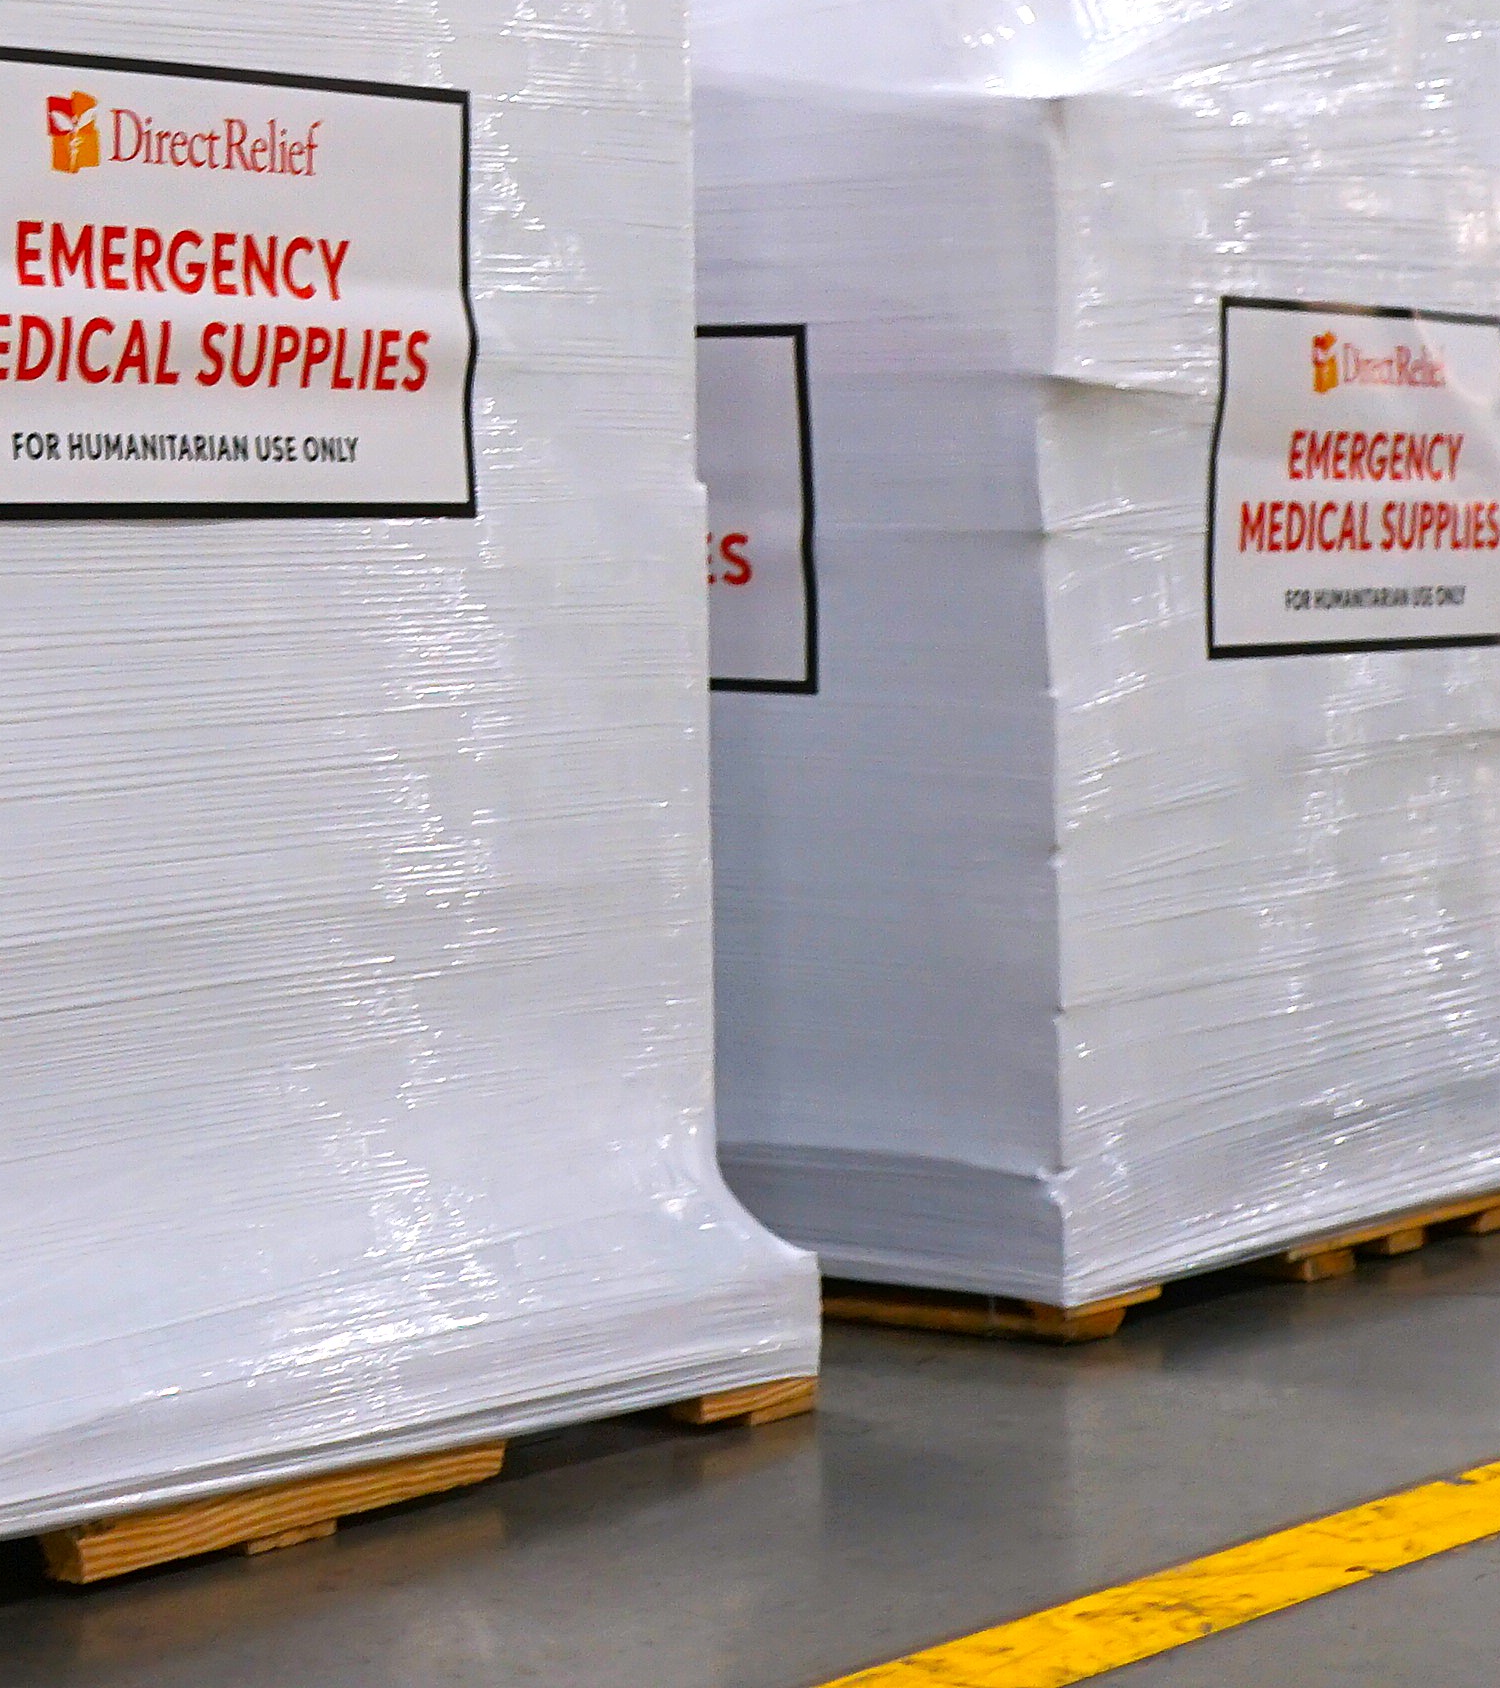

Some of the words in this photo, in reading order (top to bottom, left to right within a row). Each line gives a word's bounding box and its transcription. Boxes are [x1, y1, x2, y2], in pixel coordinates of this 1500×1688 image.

[107, 107, 218, 171] Direct
[220, 116, 324, 179] Relief
[14, 219, 351, 302] EMERGENCY
[194, 320, 431, 393] SUPPLIES
[12, 431, 61, 461] FOR
[68, 432, 249, 462] HUMANITARIAN
[255, 435, 298, 463] USE
[303, 436, 359, 463] ONLY
[1286, 427, 1465, 483] EMERGENCY
[1237, 499, 1374, 554] MEDICAL
